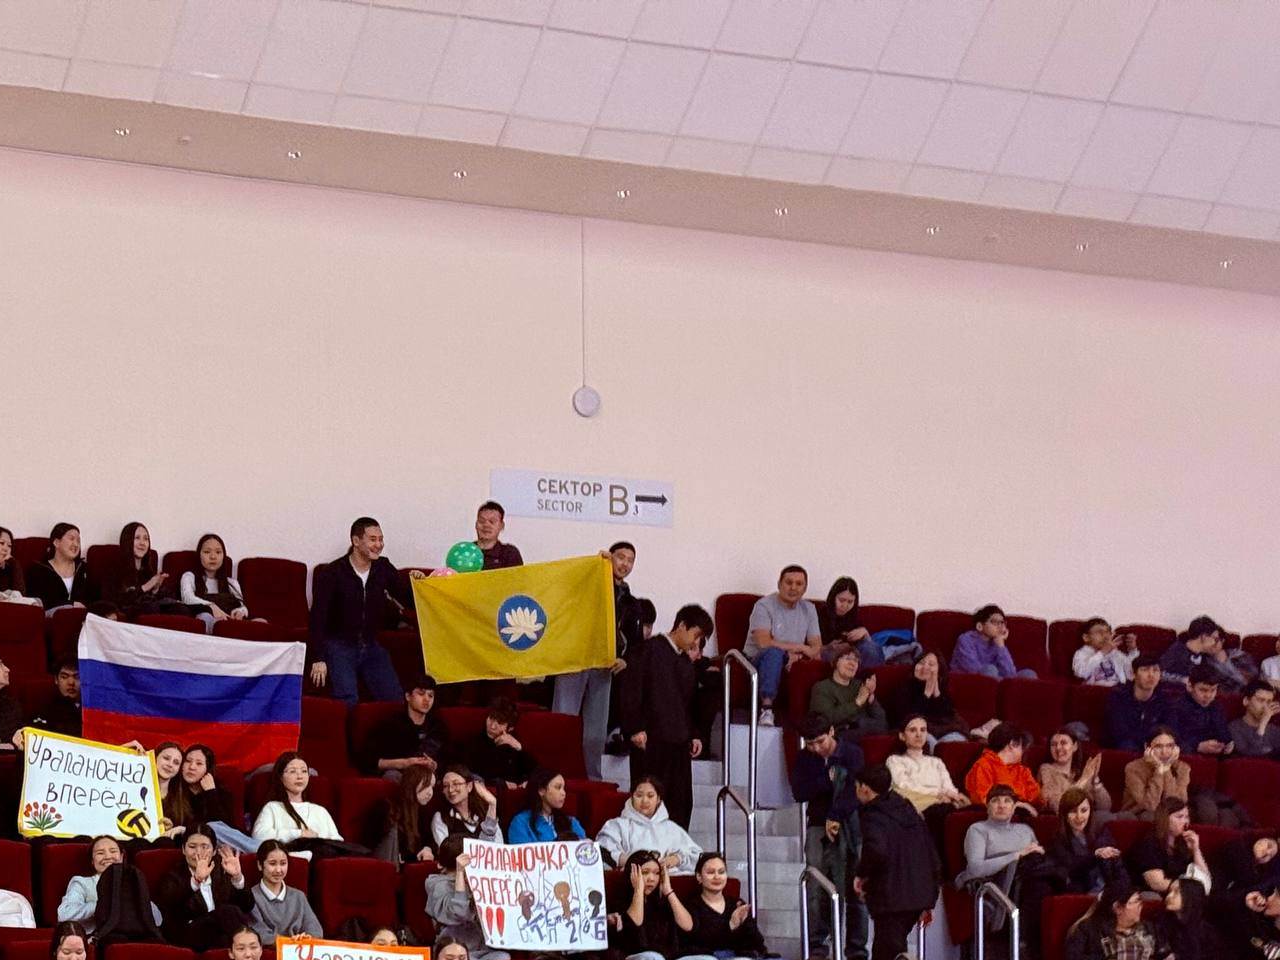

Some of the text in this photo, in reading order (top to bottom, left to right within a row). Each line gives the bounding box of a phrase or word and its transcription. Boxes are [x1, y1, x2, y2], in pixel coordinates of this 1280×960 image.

[537, 478, 602, 497] СЕКТОР
[537, 499, 583, 513] SECTOR
[469, 843, 569, 872] УРАЛАНОЧКА
